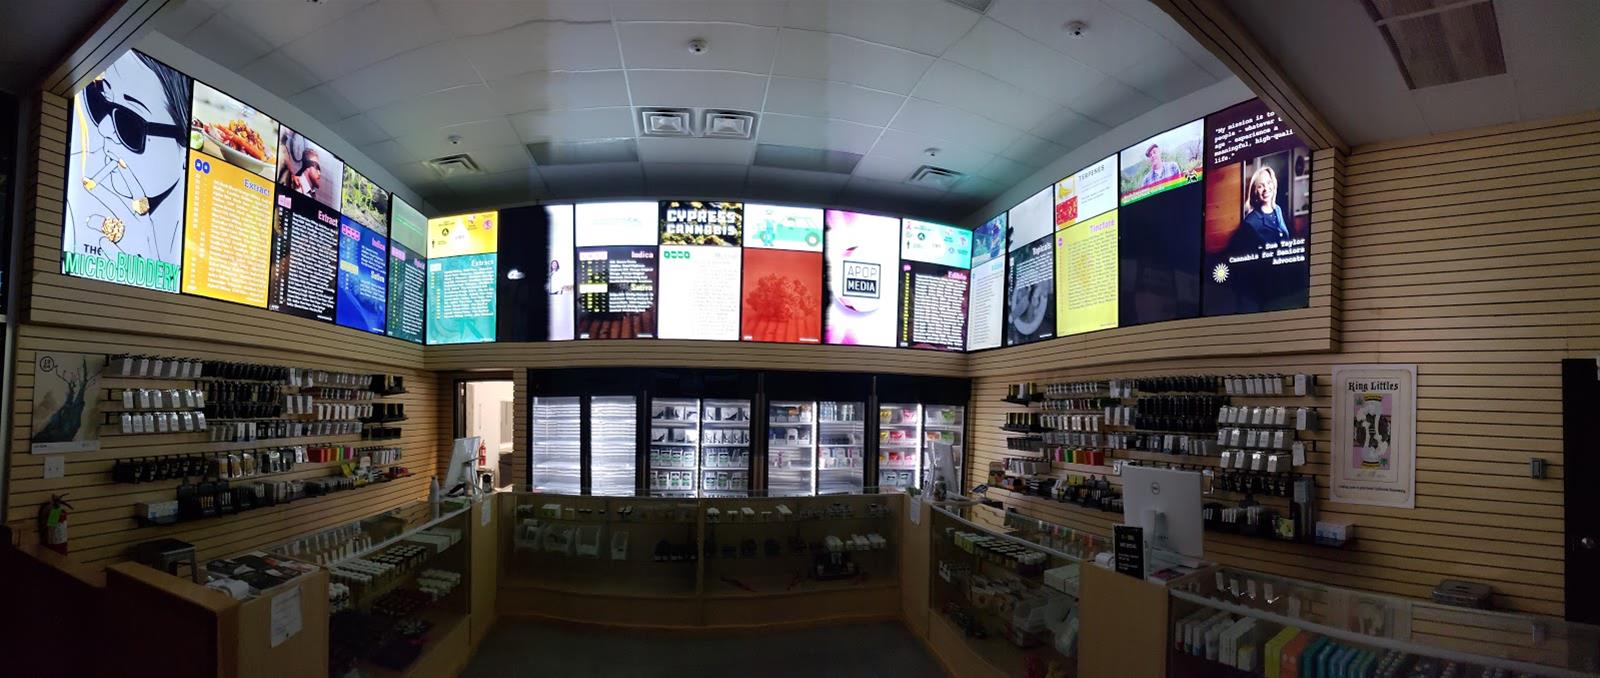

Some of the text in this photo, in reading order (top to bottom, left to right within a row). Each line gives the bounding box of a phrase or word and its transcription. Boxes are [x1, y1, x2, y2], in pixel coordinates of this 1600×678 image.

[1228, 118, 1253, 130] mission
[1255, 114, 1264, 122] is
[1214, 131, 1236, 143] people
[1244, 119, 1275, 132] whatever
[1254, 128, 1293, 145] high-quali
[1214, 142, 1226, 150] age
[1234, 127, 1271, 143] experience
[1077, 164, 1105, 182] TERPENES
[243, 178, 270, 197] Extract
[317, 210, 339, 227] Extract
[666, 209, 736, 224] CYPRESS
[666, 223, 736, 236] CANNABIS
[84, 242, 103, 256] THE
[1032, 242, 1053, 255] Topicals
[1280, 237, 1305, 249] Taylor
[631, 250, 654, 259] Indica
[1229, 246, 1305, 264] Cannabis for Seniors
[1272, 255, 1305, 266] Advocate
[847, 265, 878, 278] APOP
[948, 270, 968, 281] Edible
[847, 280, 877, 293] MEDIA
[1348, 380, 1400, 392] King Littles
